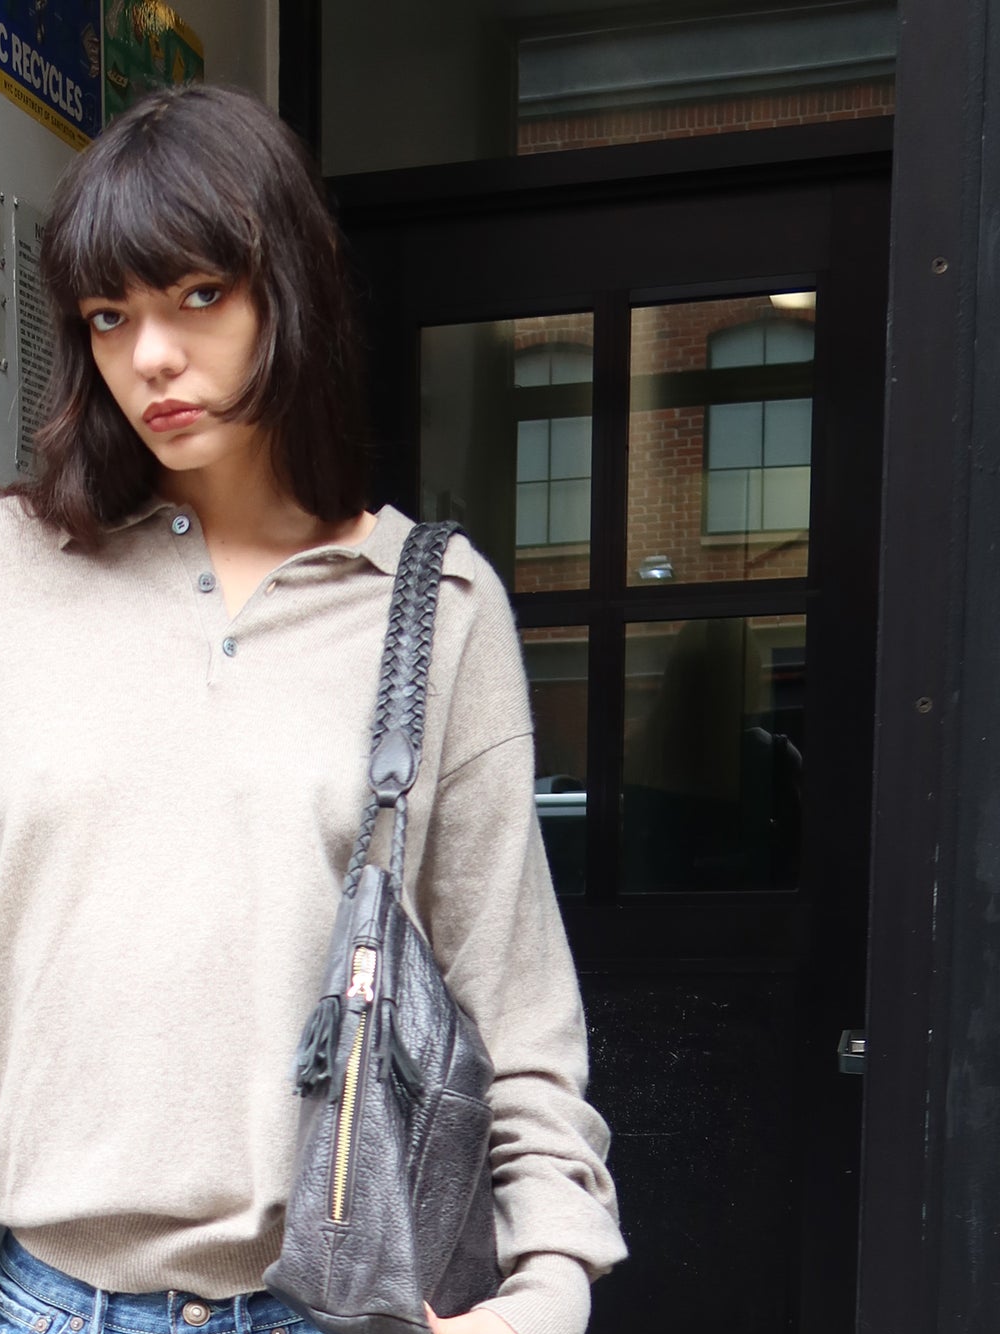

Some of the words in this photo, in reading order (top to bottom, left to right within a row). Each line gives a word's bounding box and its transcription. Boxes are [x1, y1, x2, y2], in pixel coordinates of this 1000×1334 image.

[4, 79, 13, 94] NYC
[14, 85, 43, 116] DEPARTMENT
[11, 32, 83, 122] RECYCLES
